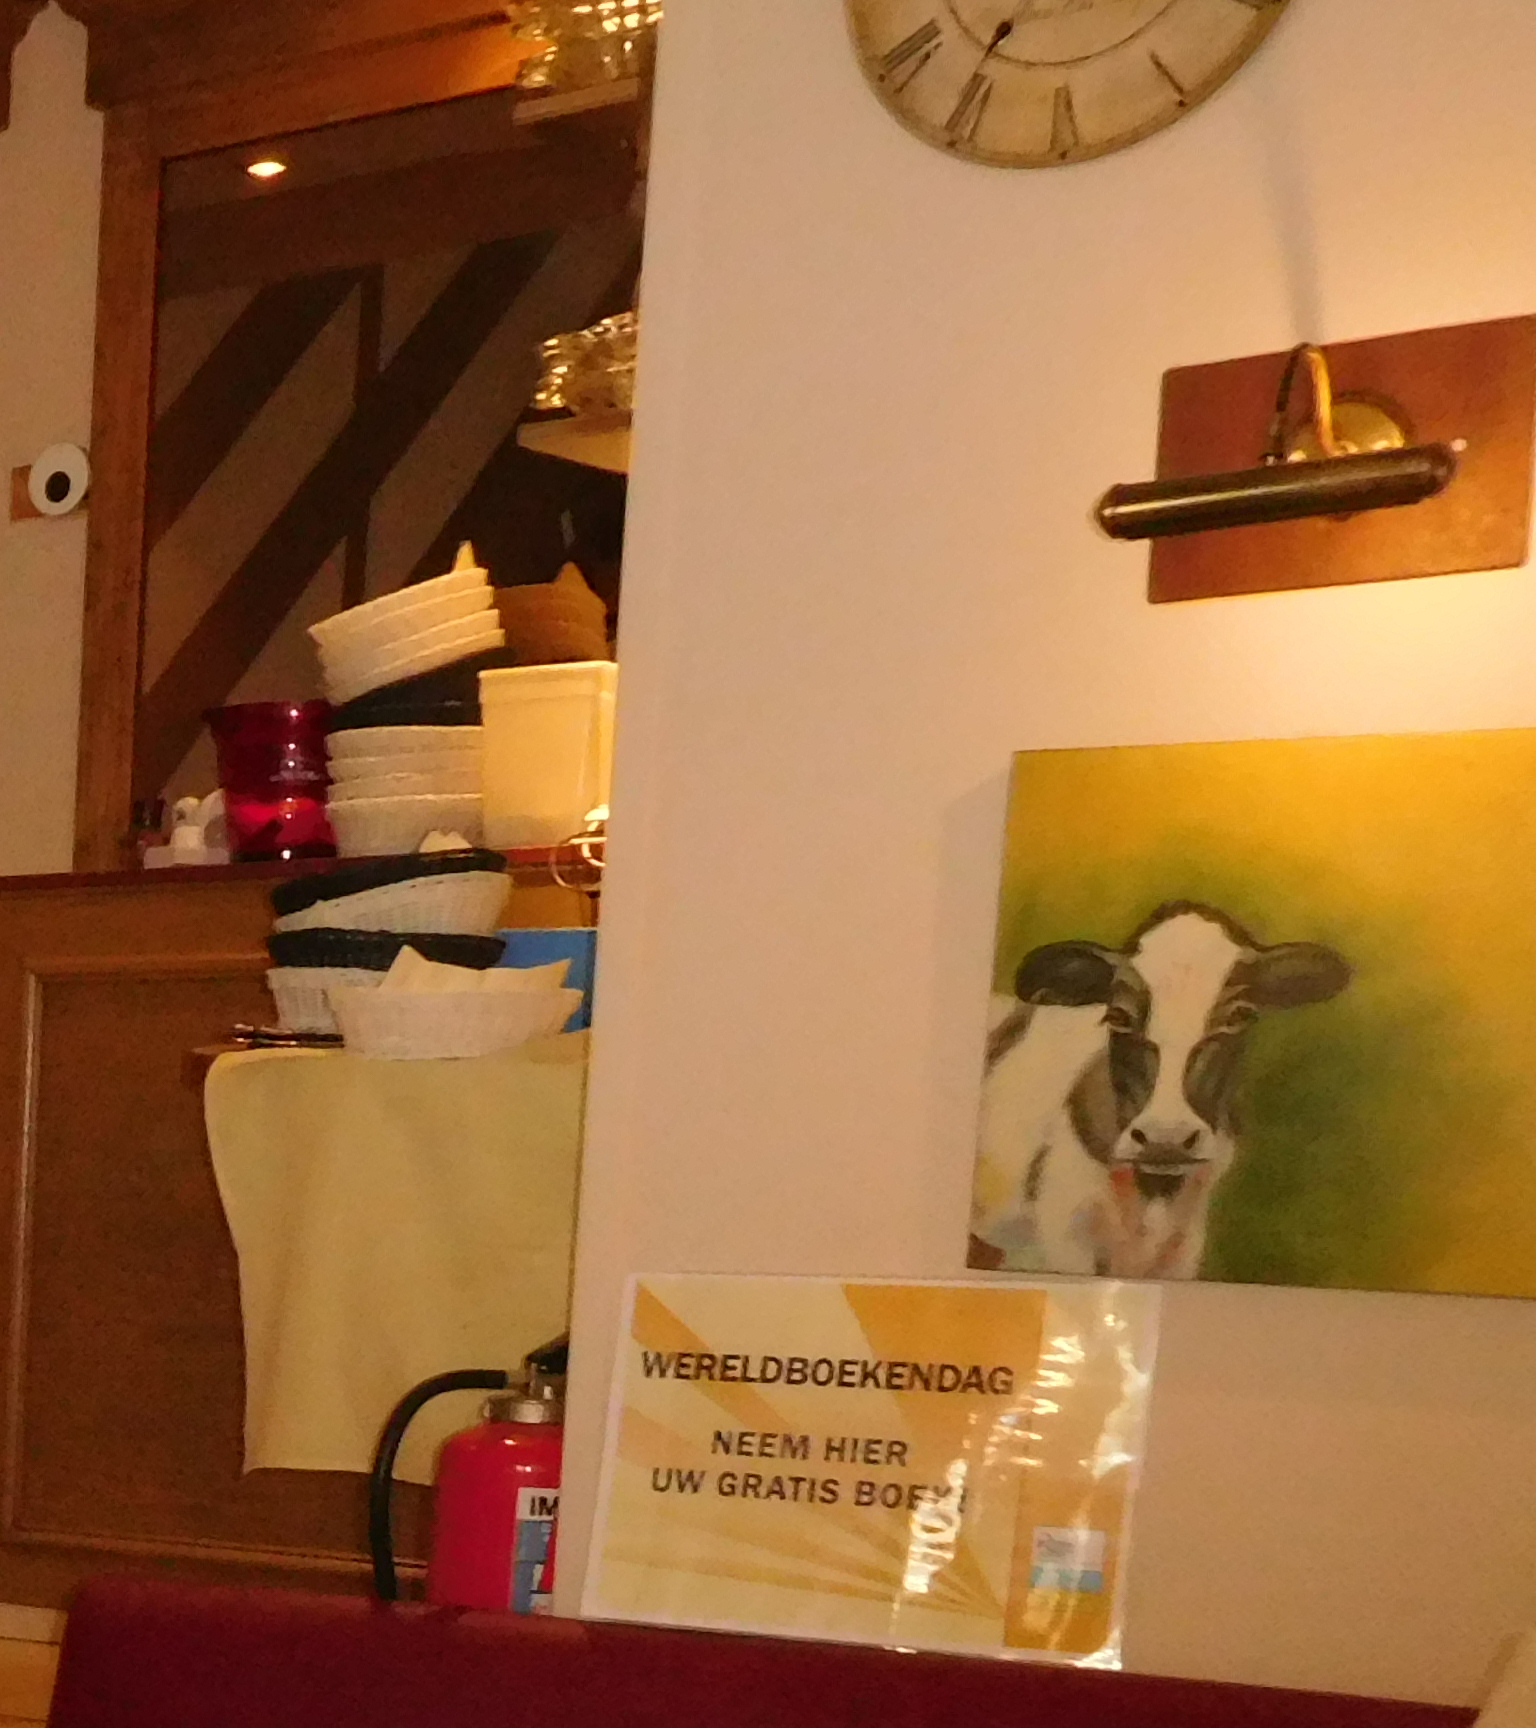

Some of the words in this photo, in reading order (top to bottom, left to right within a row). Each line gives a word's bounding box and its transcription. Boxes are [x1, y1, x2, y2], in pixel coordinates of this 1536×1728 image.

[641, 1350, 1015, 1396] WERELDBOEKENDAG
[711, 1430, 810, 1461] NEEM
[824, 1437, 908, 1467] HIER
[651, 1468, 705, 1495] UW
[717, 1471, 840, 1506] GRATIS
